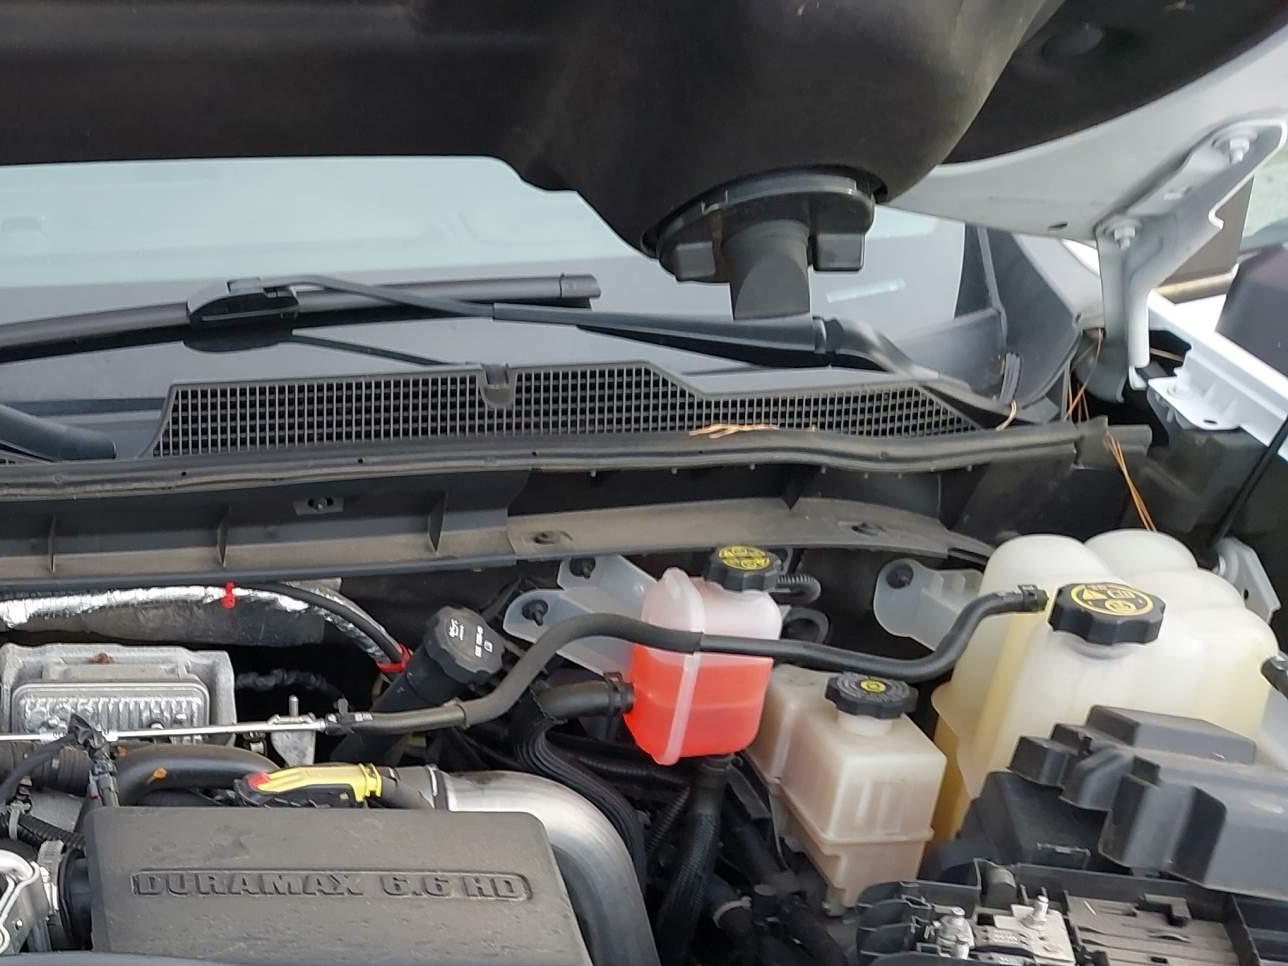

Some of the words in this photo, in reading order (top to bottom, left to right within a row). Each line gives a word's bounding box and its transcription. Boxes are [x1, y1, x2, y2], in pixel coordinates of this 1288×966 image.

[138, 872, 364, 897] DURAMAX
[380, 874, 450, 898] 6.6
[462, 876, 529, 900] HD
